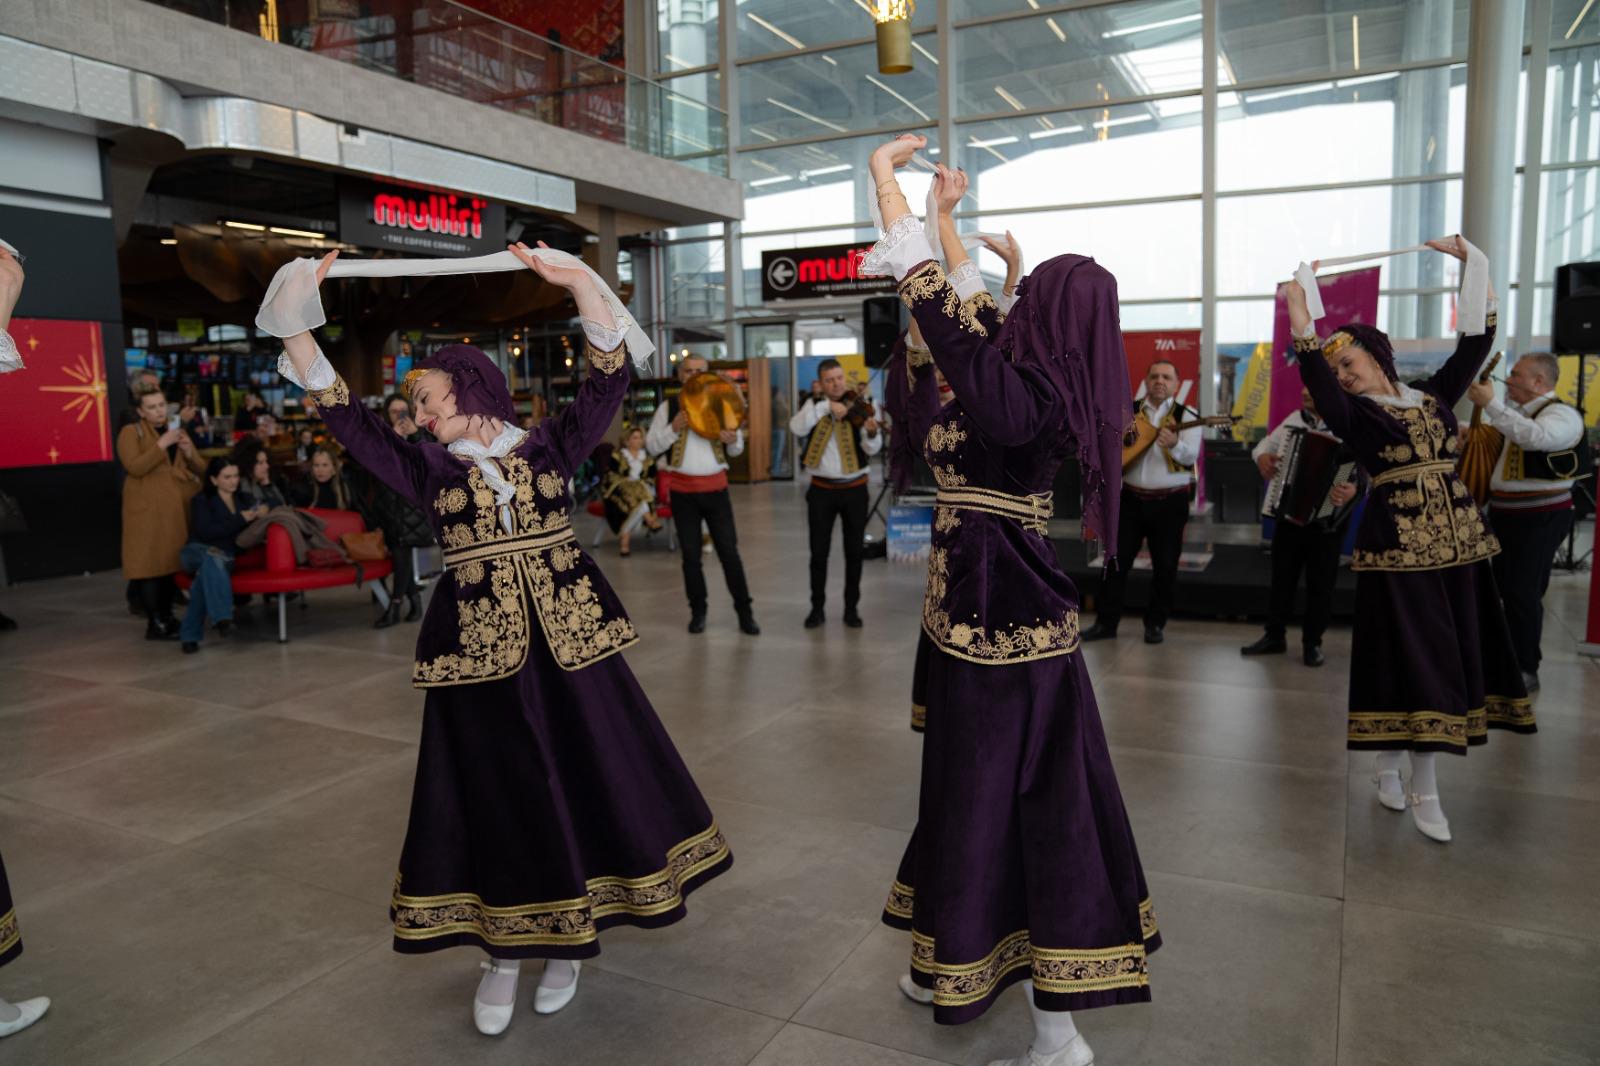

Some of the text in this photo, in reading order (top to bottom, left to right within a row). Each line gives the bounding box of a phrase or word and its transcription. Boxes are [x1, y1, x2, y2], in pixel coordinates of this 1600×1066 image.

[374, 194, 483, 239] mulliri
[388, 234, 467, 252] THE COFFEE COMPANY
